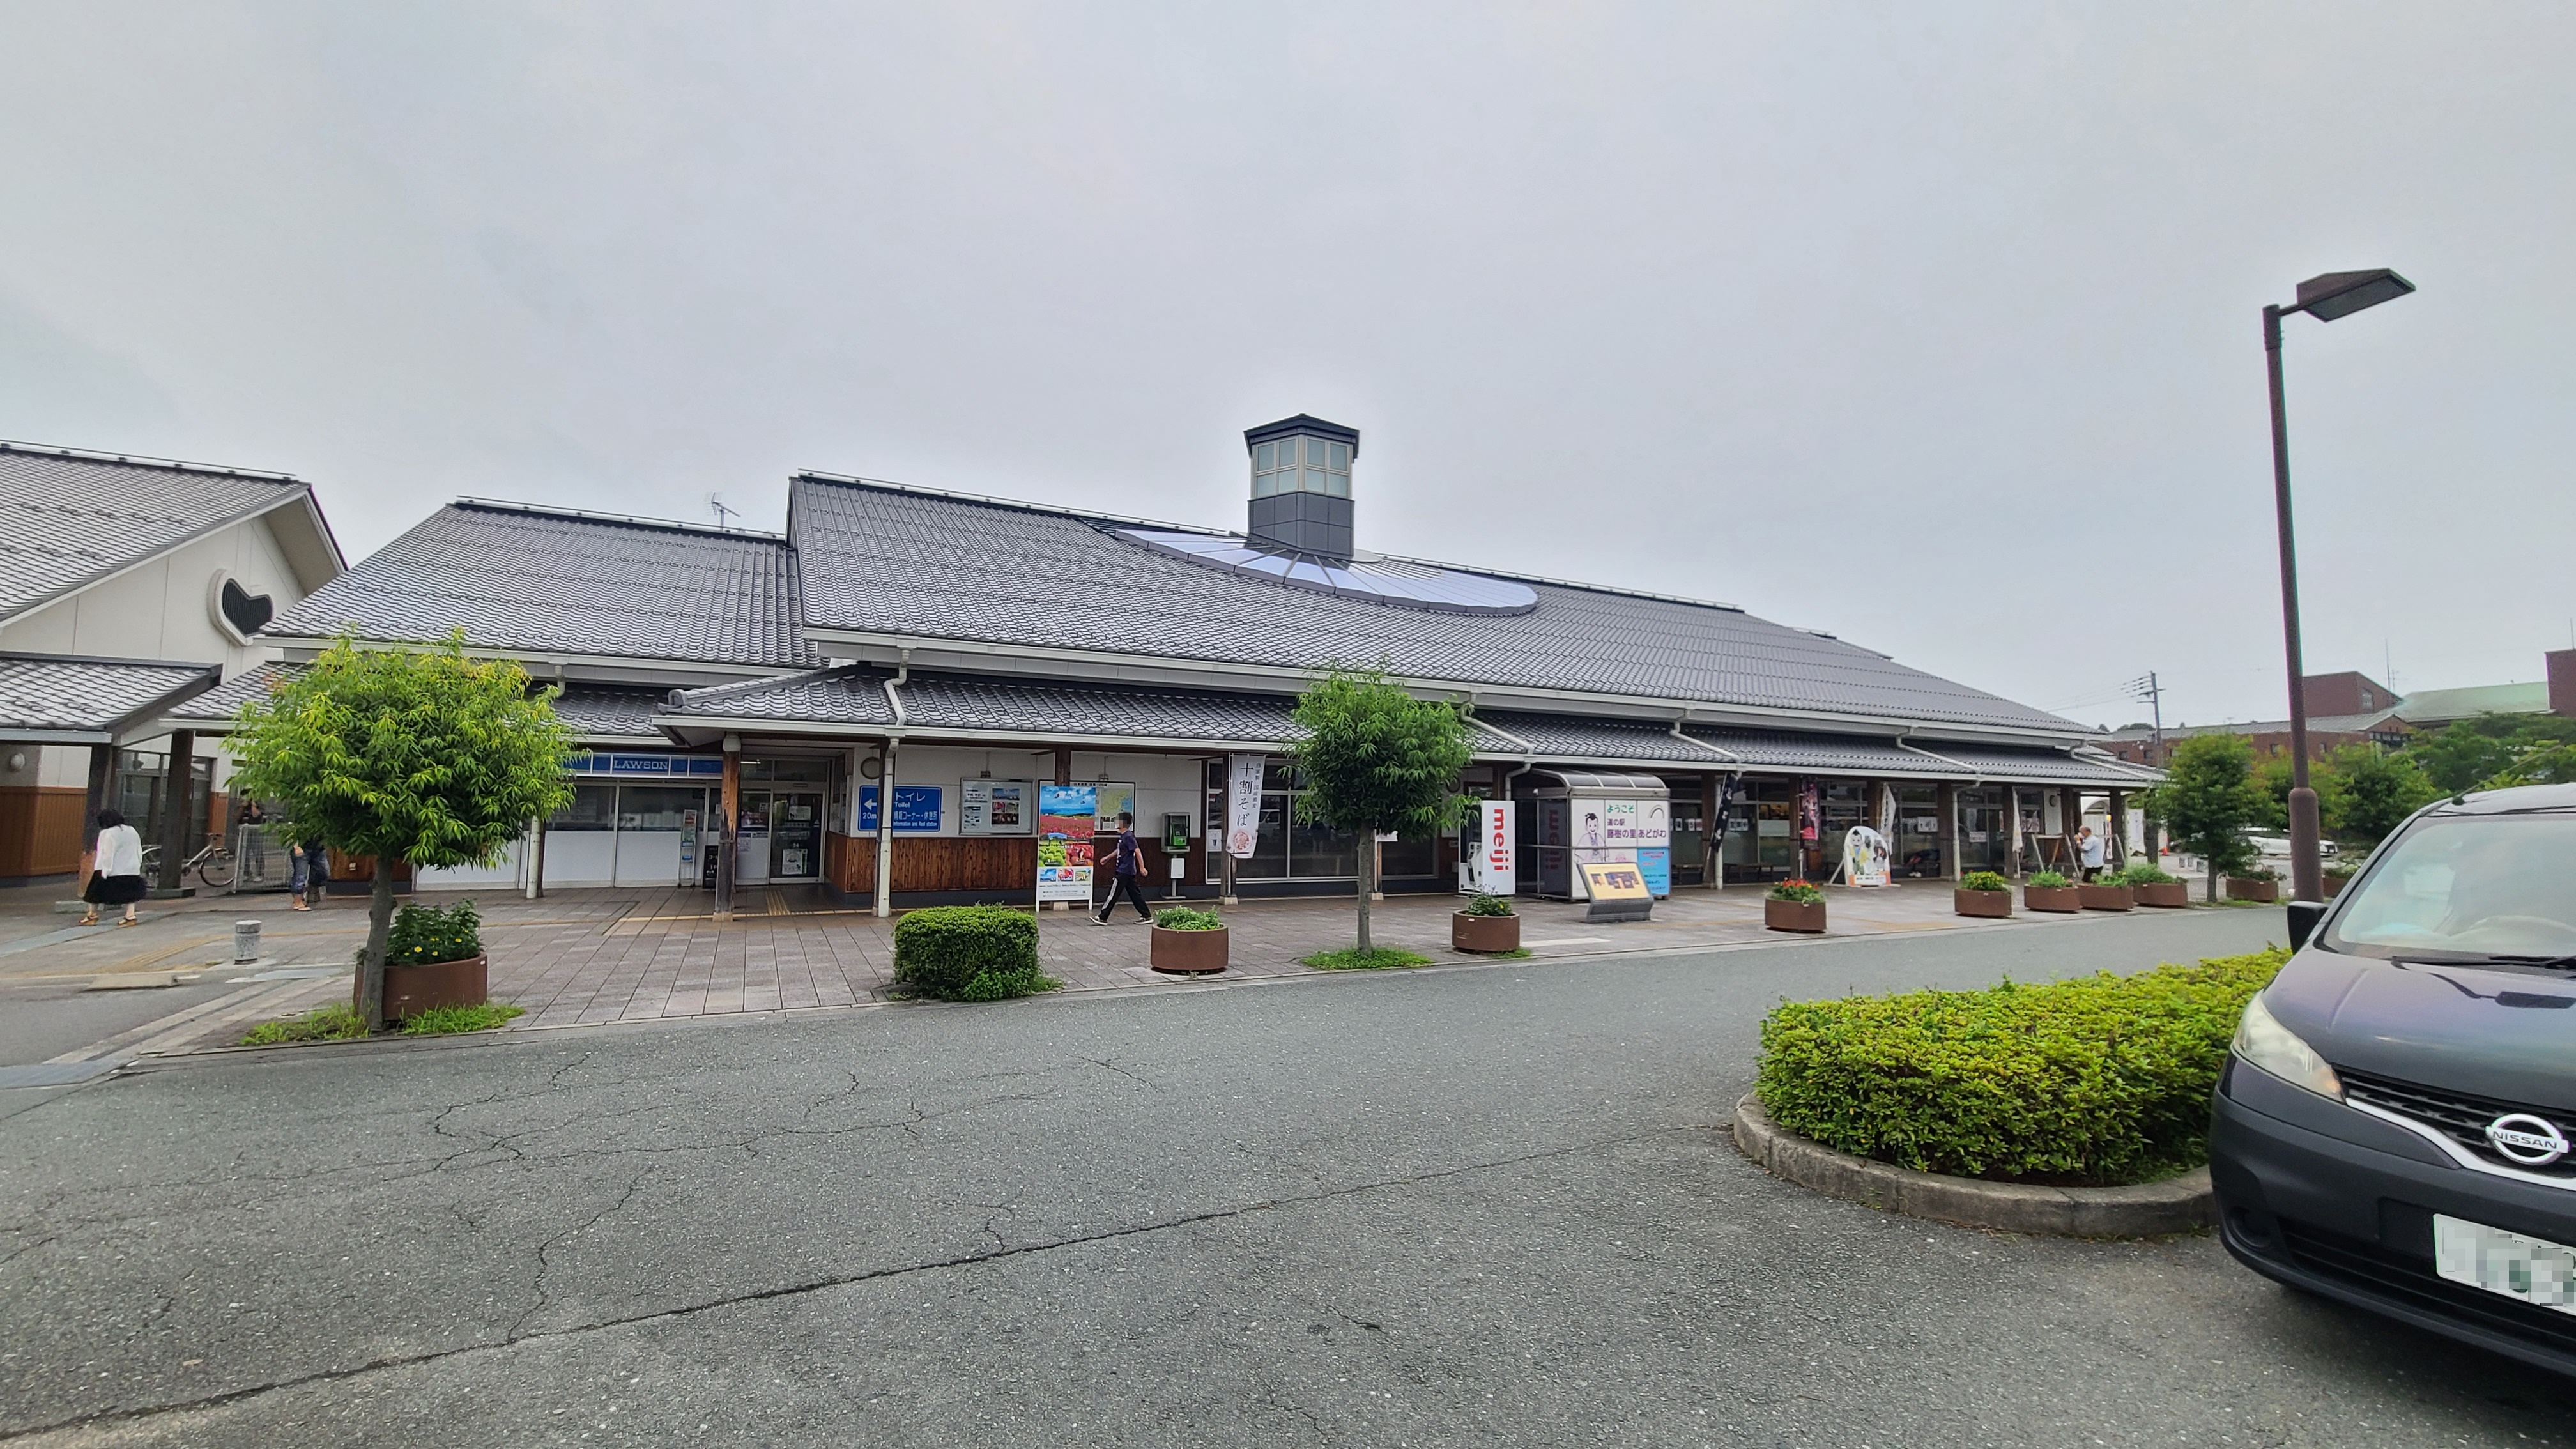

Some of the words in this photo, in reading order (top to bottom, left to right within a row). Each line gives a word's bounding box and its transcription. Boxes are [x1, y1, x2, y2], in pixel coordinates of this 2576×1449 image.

[614, 760, 668, 769] LAWSON
[896, 792, 926, 801] トイレ
[1237, 762, 1254, 827] 十割そば
[1490, 809, 1509, 870] meiji
[2493, 1131, 2557, 1149] NISSAN
